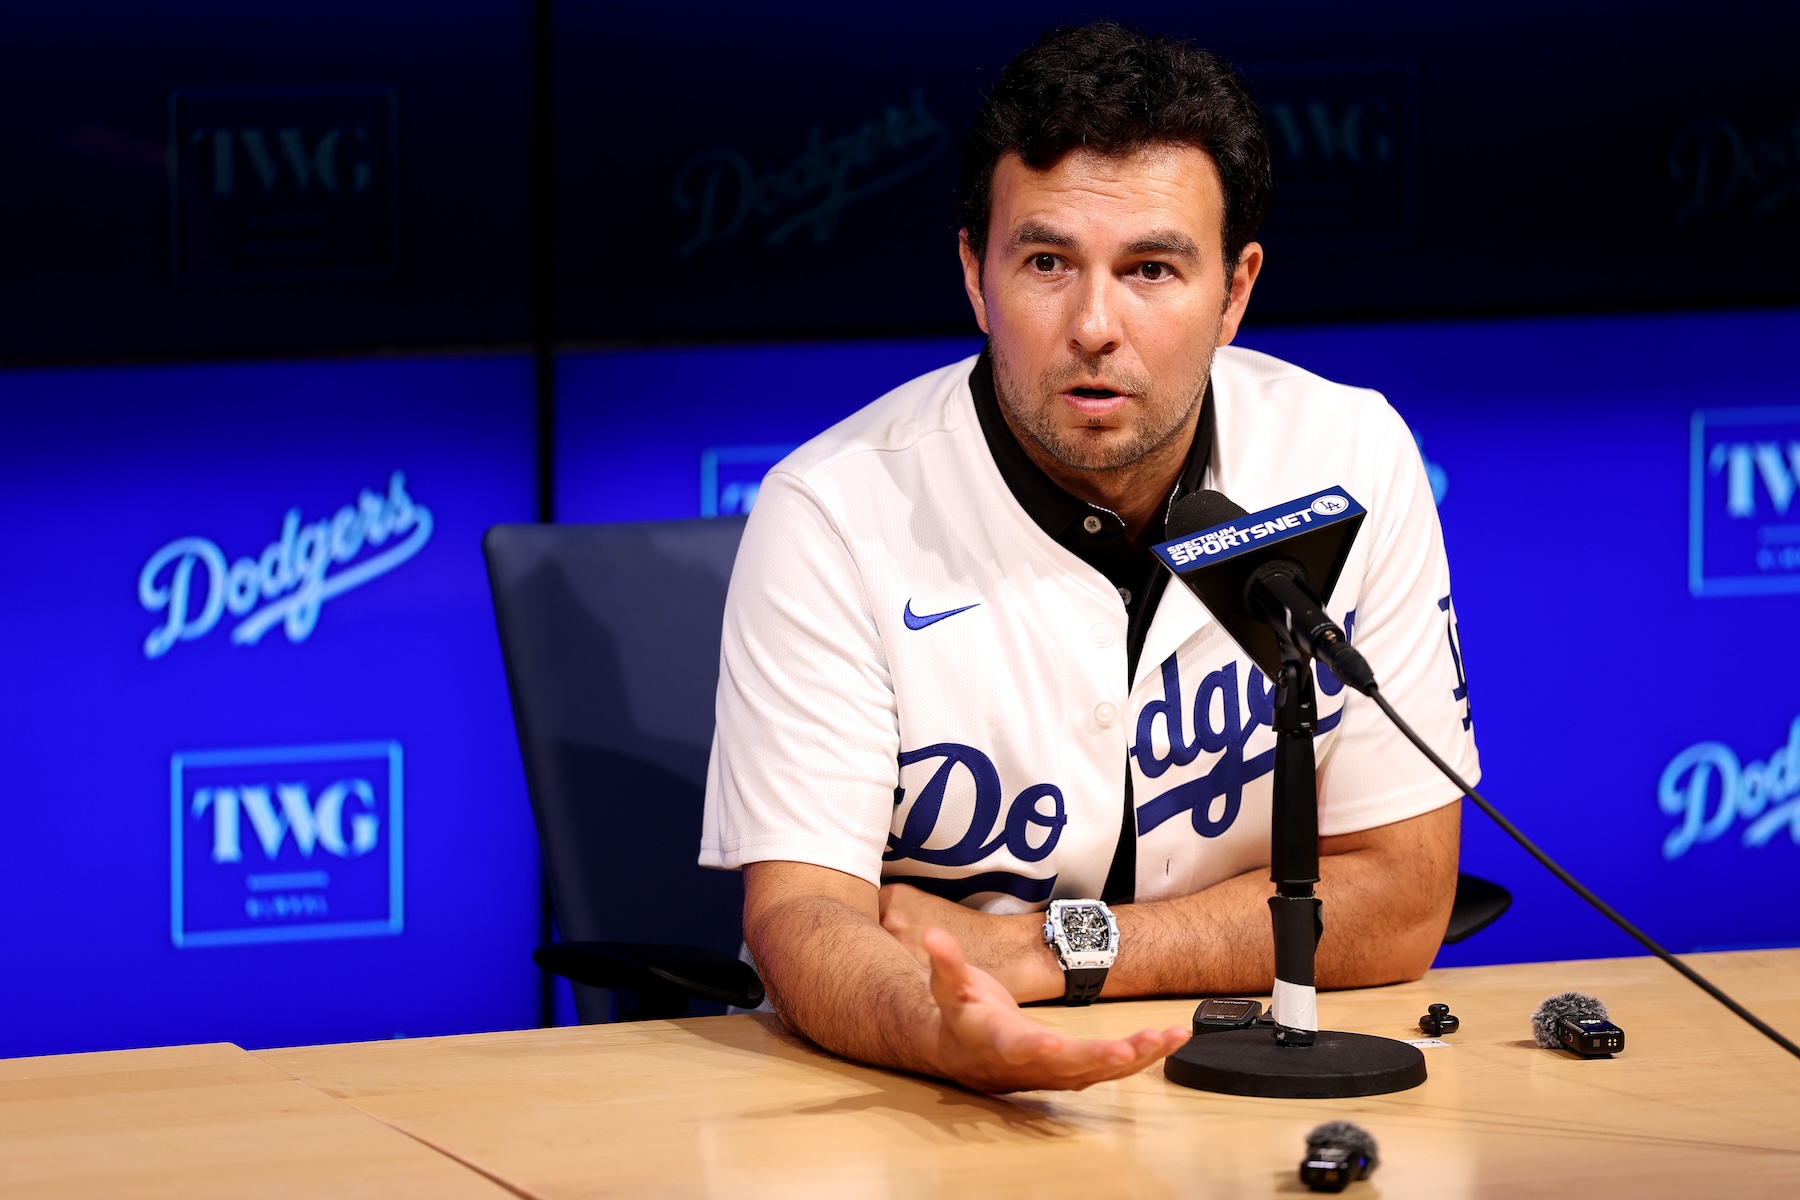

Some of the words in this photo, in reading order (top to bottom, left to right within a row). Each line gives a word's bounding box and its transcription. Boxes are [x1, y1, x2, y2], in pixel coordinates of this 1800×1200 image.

[191, 126, 372, 196] TWG
[1264, 101, 1392, 161] WG
[672, 86, 950, 257] Dodgers
[1707, 442, 1800, 518] TW
[138, 469, 434, 660] Dodgers
[1166, 525, 1237, 555] SPECTRUM
[1171, 508, 1313, 566] SPORTSNET
[191, 778, 380, 864] TWG
